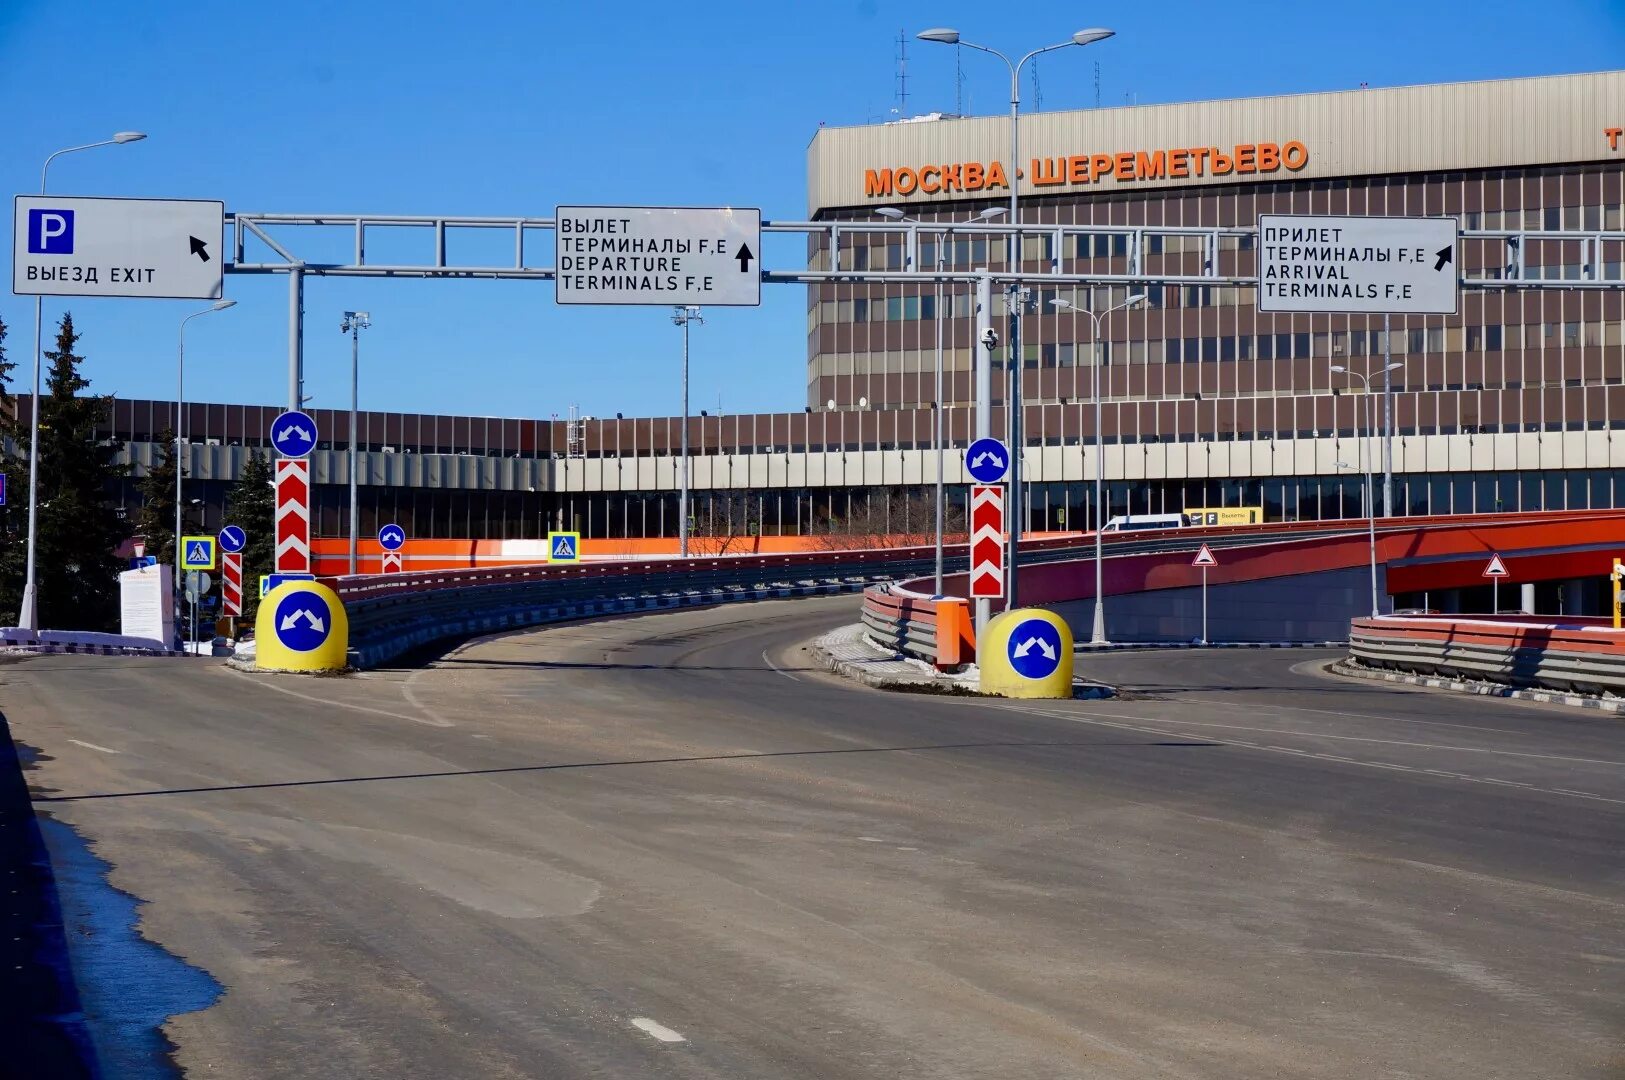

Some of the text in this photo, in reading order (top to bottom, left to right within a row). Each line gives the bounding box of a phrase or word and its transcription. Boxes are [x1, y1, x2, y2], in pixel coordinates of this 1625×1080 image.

[864, 140, 1309, 196] МОСКВА ШЕРЕМЕТЬЕВО
[40, 213, 67, 249] P
[561, 219, 631, 233] ВЫЛЕТ
[1265, 228, 1342, 242] ПРИЛЕТ
[562, 238, 726, 255] ТЕРМИНАЛЫ F,E
[1266, 247, 1425, 264] ТЕРМИНАЛЫ F,E
[562, 257, 681, 272] DEPARTURE
[1266, 265, 1349, 279] ARRIVAL
[27, 266, 156, 283] ВЫЕЗД EXIT
[562, 275, 713, 292] TERMINALS F,E
[1266, 283, 1412, 300] TERMINALS F,E
